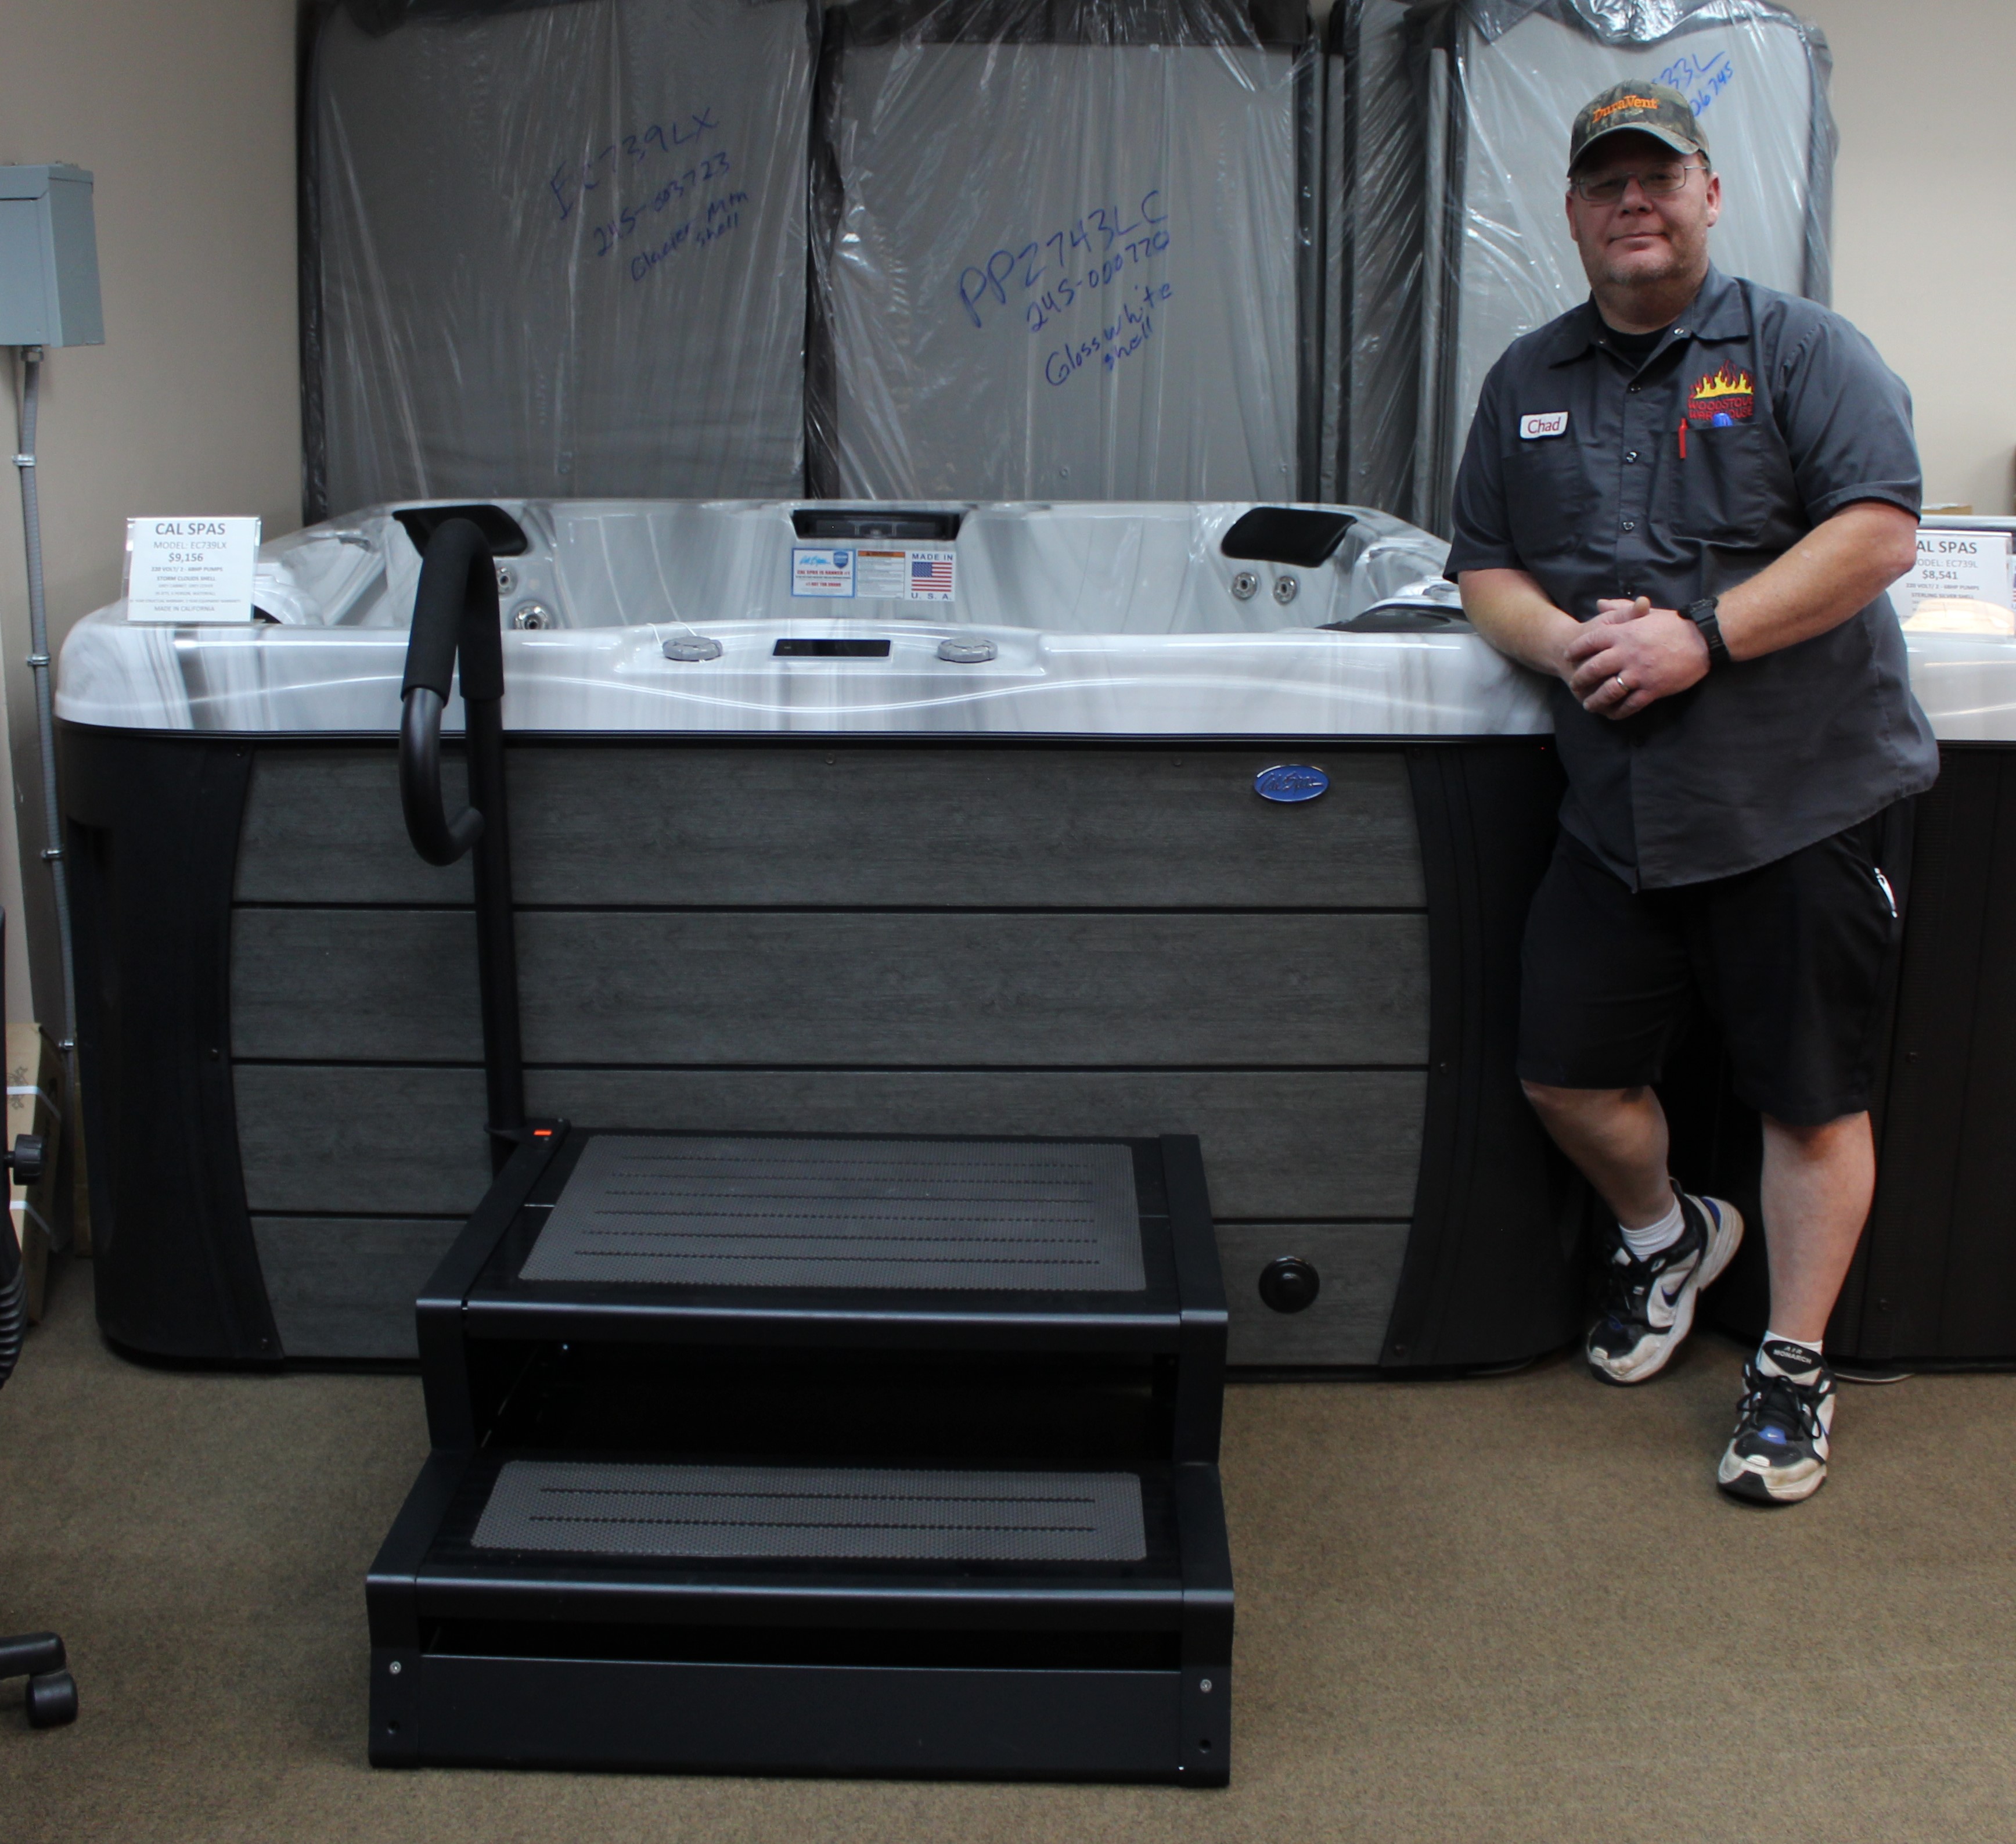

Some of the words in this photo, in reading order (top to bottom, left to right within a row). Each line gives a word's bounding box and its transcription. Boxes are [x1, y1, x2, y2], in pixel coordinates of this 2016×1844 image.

[1651, 51, 1725, 89] 33L
[1592, 94, 1659, 123] DuraVent
[1046, 336, 1100, 386] Gloss
[1689, 407, 1753, 420] WAROUSE
[1528, 417, 1561, 434] Chad
[156, 523, 183, 535] CAL
[188, 523, 226, 535] SPAS
[1916, 541, 1934, 552] AL
[1938, 541, 1977, 554] SPAS
[168, 552, 203, 563] $9,156
[1917, 559, 1943, 567] ODEL:
[1946, 560, 1978, 568] EC739L
[1923, 570, 1957, 580] $8,541
[1784, 1346, 1802, 1354] AIR
[1773, 1349, 1812, 1365] MONARCH
